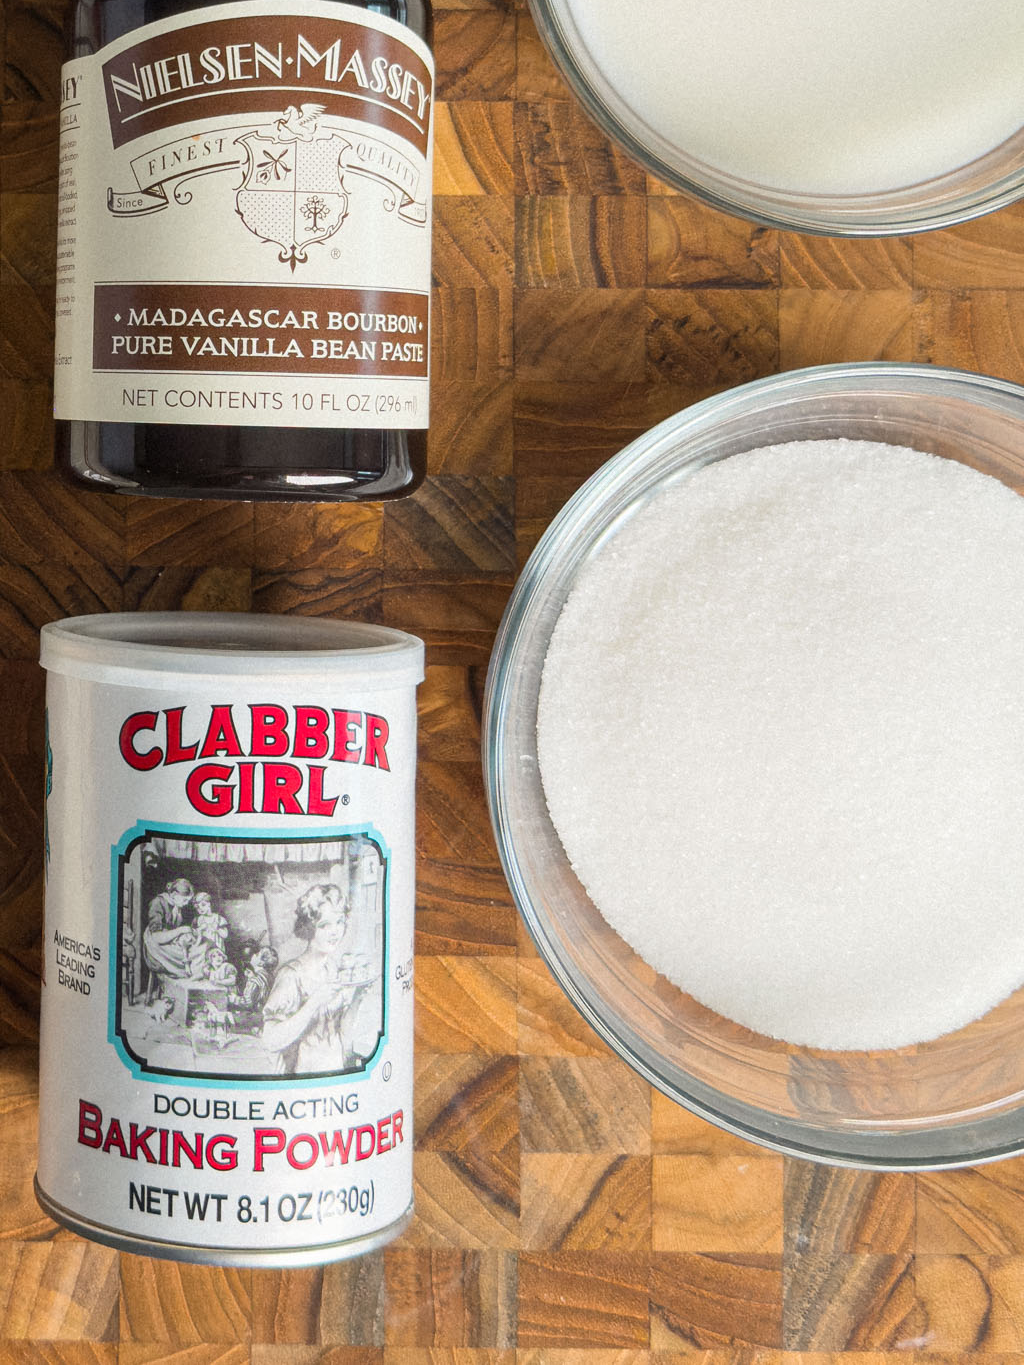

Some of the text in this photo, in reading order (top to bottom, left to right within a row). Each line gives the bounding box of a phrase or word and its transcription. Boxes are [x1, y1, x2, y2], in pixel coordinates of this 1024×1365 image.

[147, 137, 228, 178] FINEST
[355, 142, 415, 188] QUALITY
[116, 195, 144, 210] Since
[126, 308, 418, 335] MADAGASCAR BOURBON
[110, 335, 424, 363] PURE VANILLA BEAN PASTE
[121, 388, 159, 407] NET
[164, 389, 284, 411] CONTENTS
[291, 392, 314, 411] 10
[320, 393, 341, 411] FL
[346, 393, 371, 413] OZ
[374, 395, 402, 414] (296
[118, 703, 391, 773] CLABBER
[53, 929, 101, 962] AMERICA'S
[56, 948, 96, 979] LEADING
[58, 968, 91, 996] BRAND
[153, 1093, 360, 1121] DOUBLE ACTING
[77, 1098, 405, 1173] BAKING POWDER
[128, 1179, 376, 1226] NET WT 8.1 OZ (230g)
